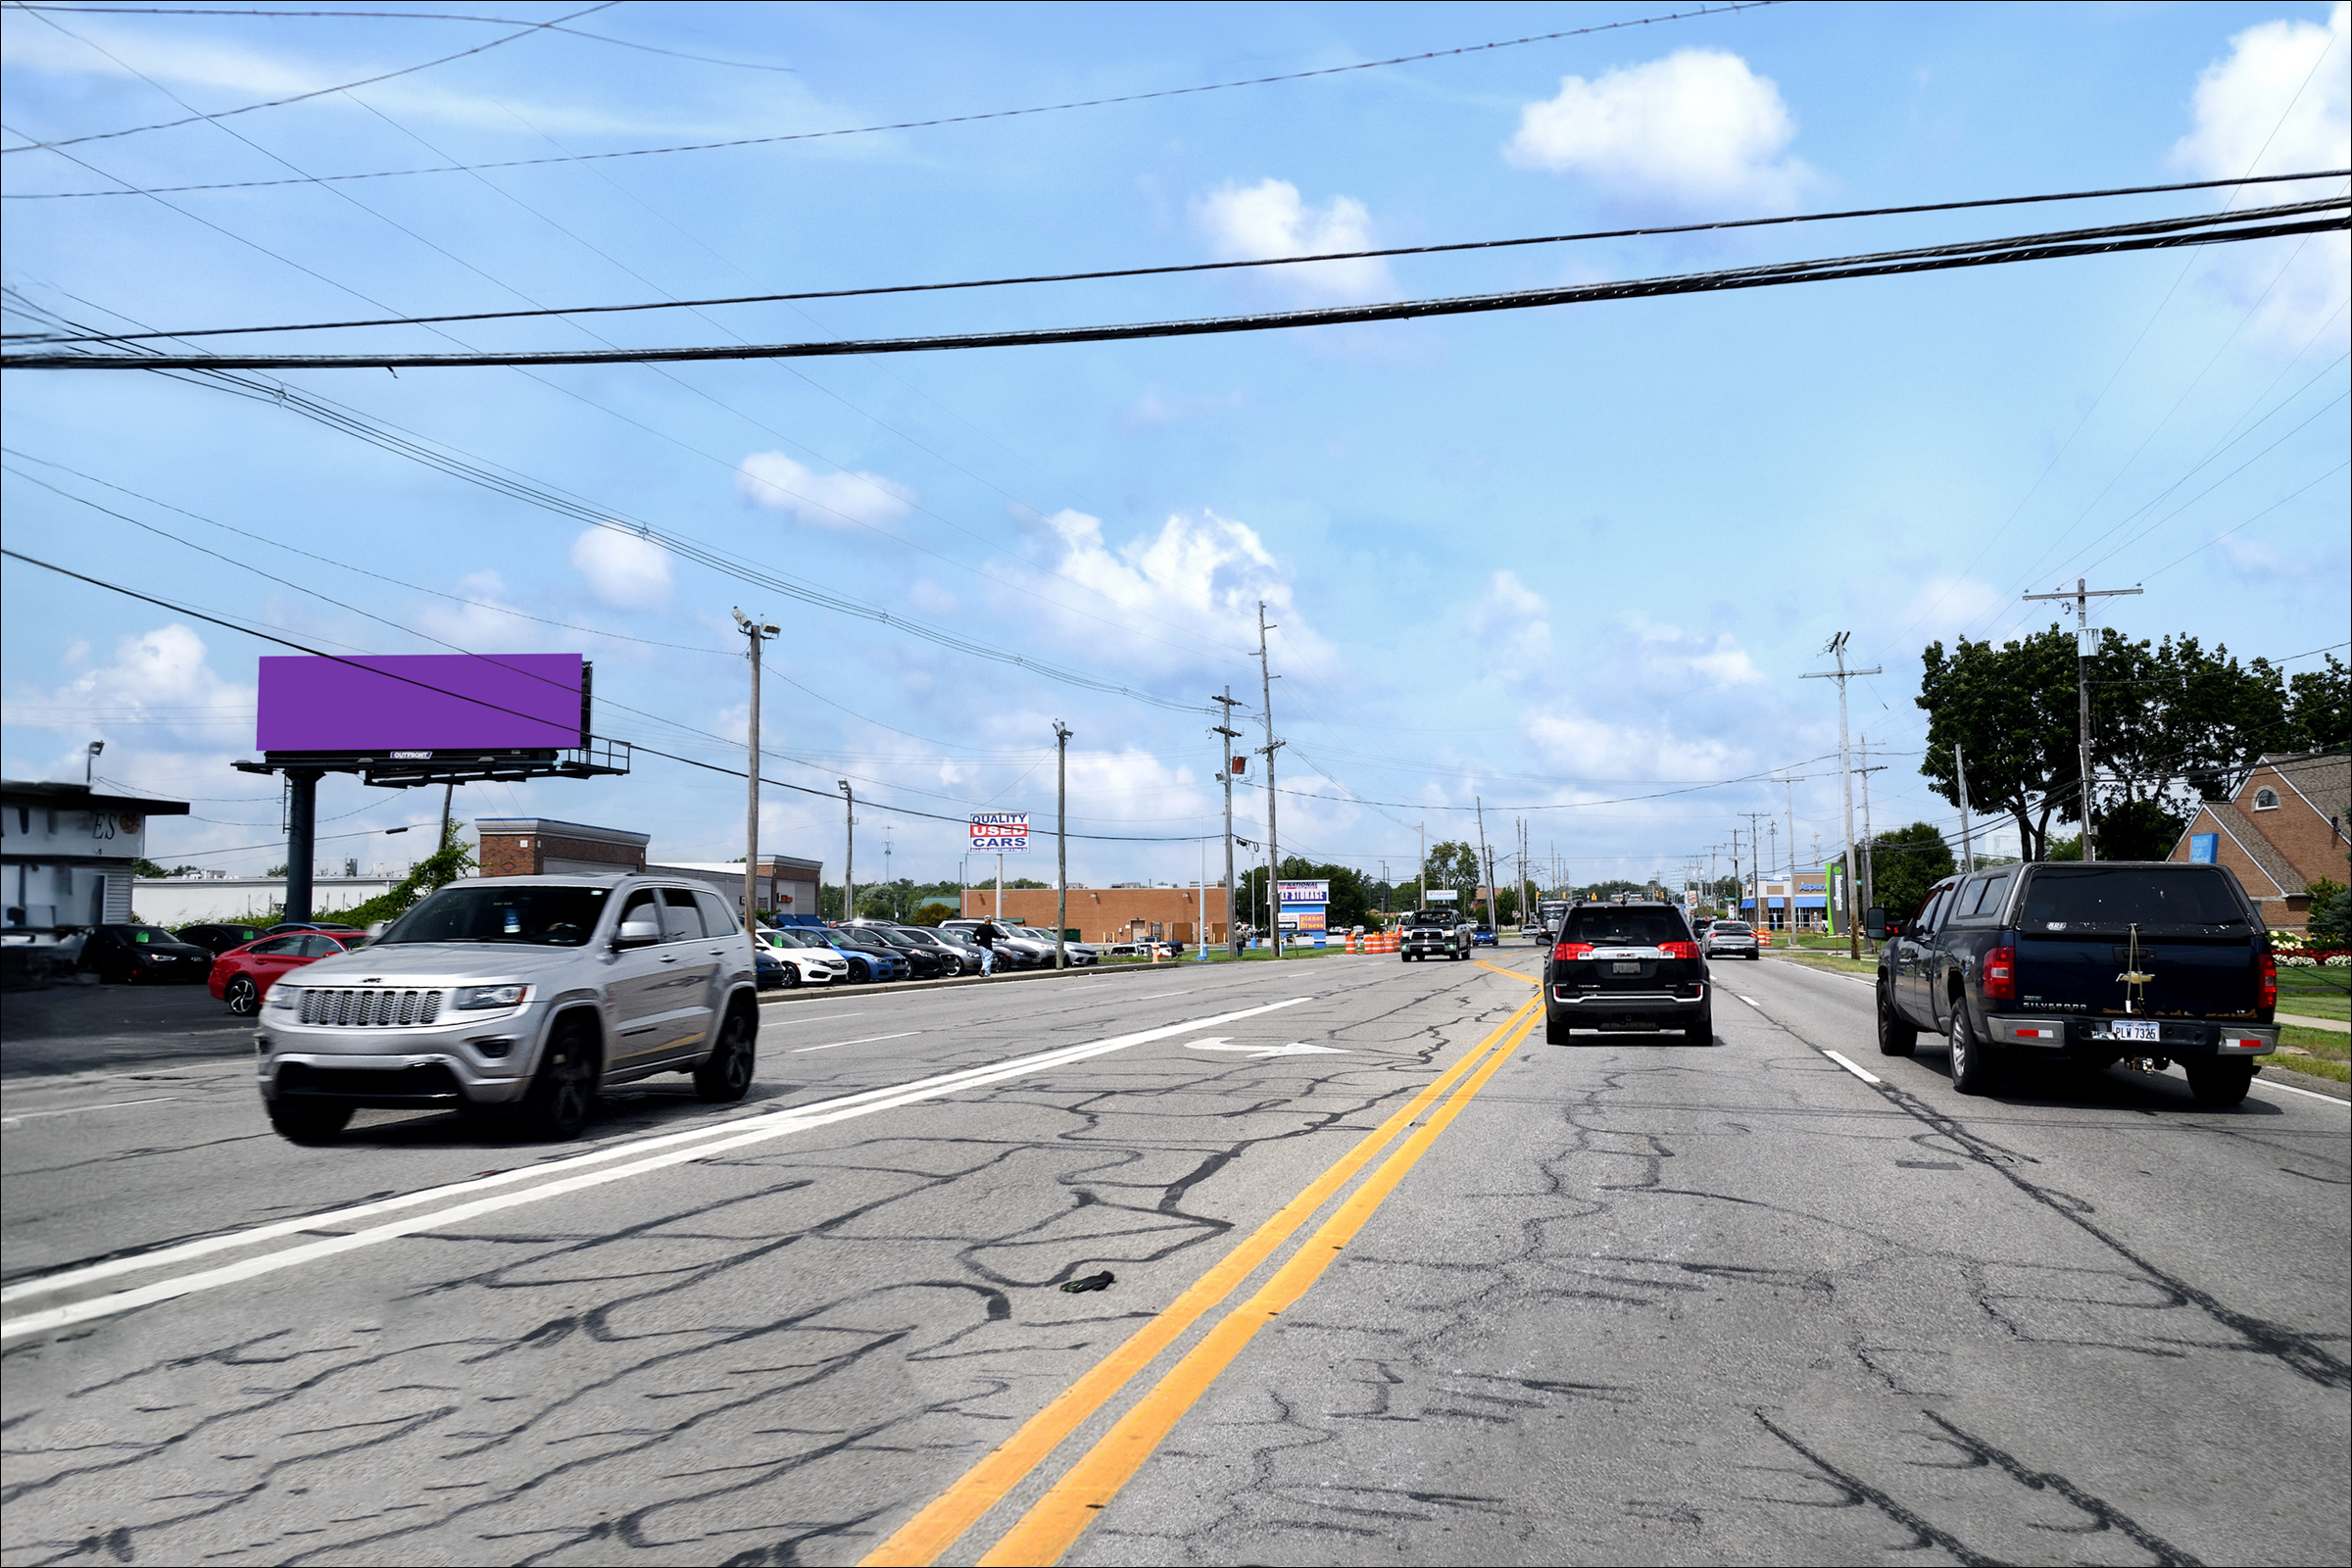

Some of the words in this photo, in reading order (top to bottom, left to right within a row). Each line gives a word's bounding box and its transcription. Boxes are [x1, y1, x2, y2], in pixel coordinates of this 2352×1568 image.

[972, 814, 1026, 824] QUALITY
[973, 826, 1026, 836] USED
[972, 838, 1026, 848] CARS
[1799, 882, 1826, 893] Aspen
[1291, 891, 1324, 901] STORAGE
[2116, 1027, 2132, 1039] PLW
[2135, 1028, 2156, 1040] 7325
